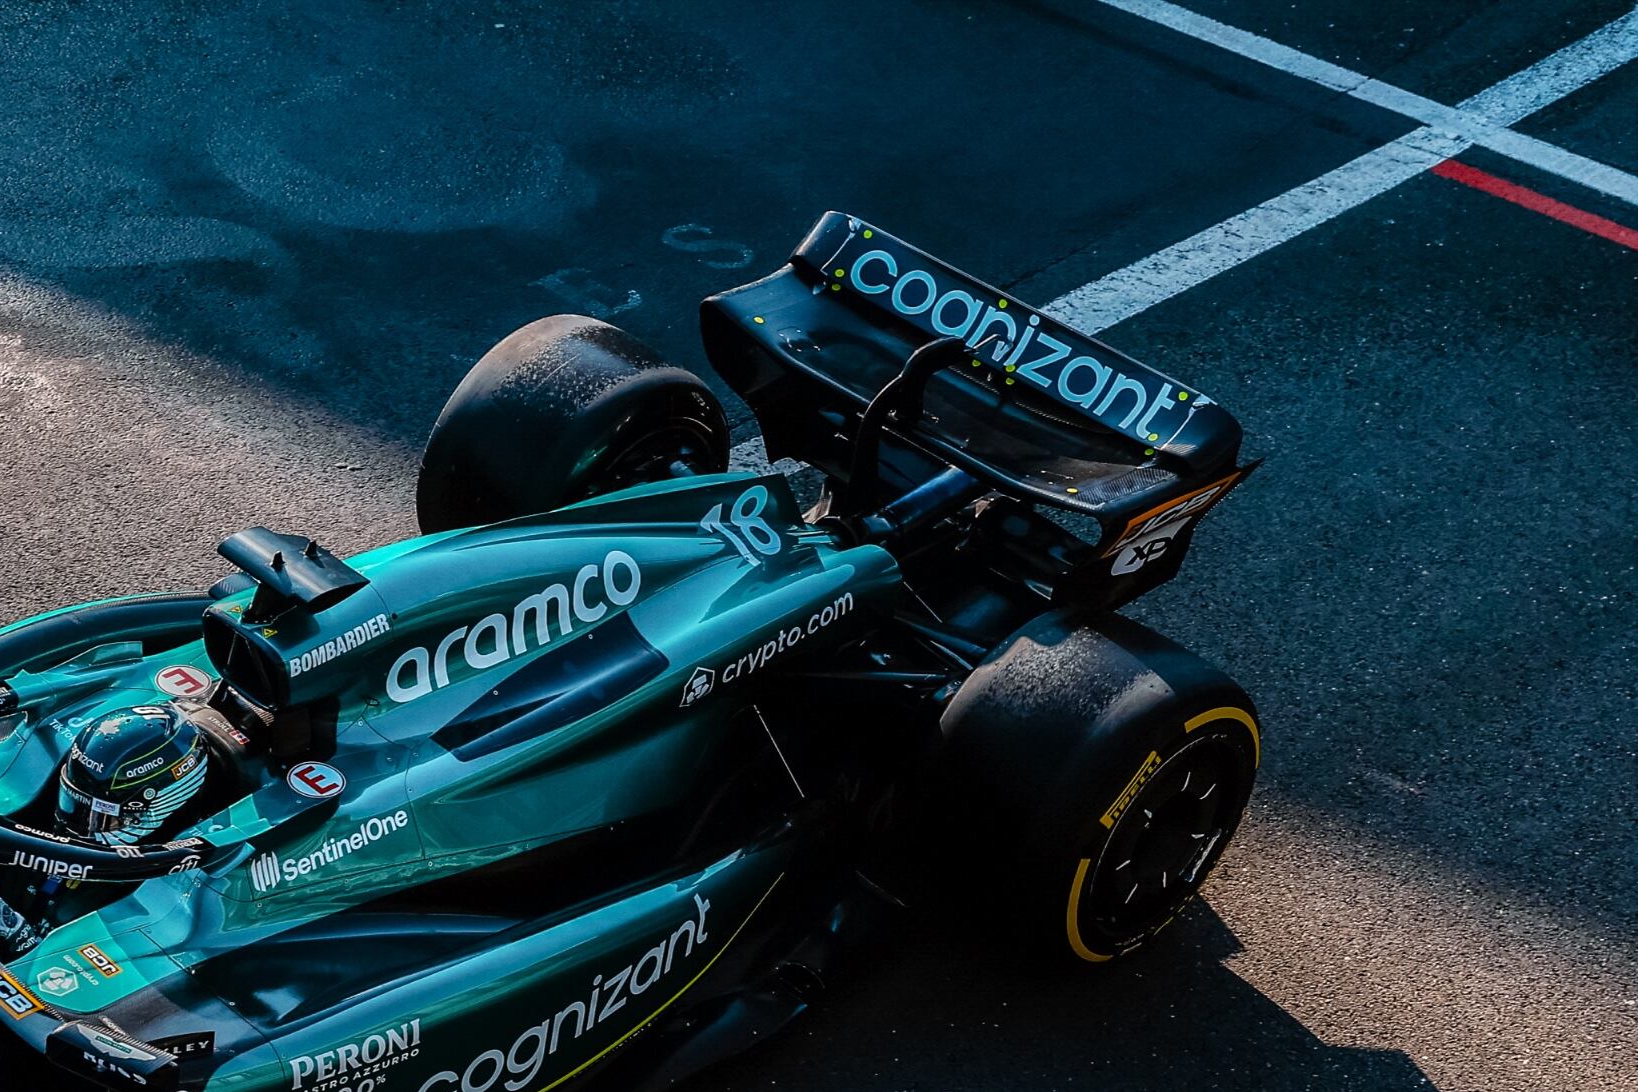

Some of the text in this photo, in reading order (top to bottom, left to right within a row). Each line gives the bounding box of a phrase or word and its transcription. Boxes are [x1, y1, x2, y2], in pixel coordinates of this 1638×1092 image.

[700, 485, 782, 568] 18
[1115, 486, 1221, 549] JCB
[288, 612, 393, 679] BOMBARDIER
[385, 550, 642, 704] aramco
[721, 590, 855, 687] crypto.com
[126, 757, 164, 779] aramco
[176, 760, 196, 778] JCB
[297, 767, 340, 798] E
[1099, 750, 1162, 830] PIRELLI
[14, 823, 71, 844] aramco
[282, 808, 409, 882] SentinelOne
[63, 954, 100, 986] crypto.com
[82, 946, 117, 973] JCB
[289, 1018, 422, 1091] PERONI
[352, 1048, 420, 1081] AZZURRO
